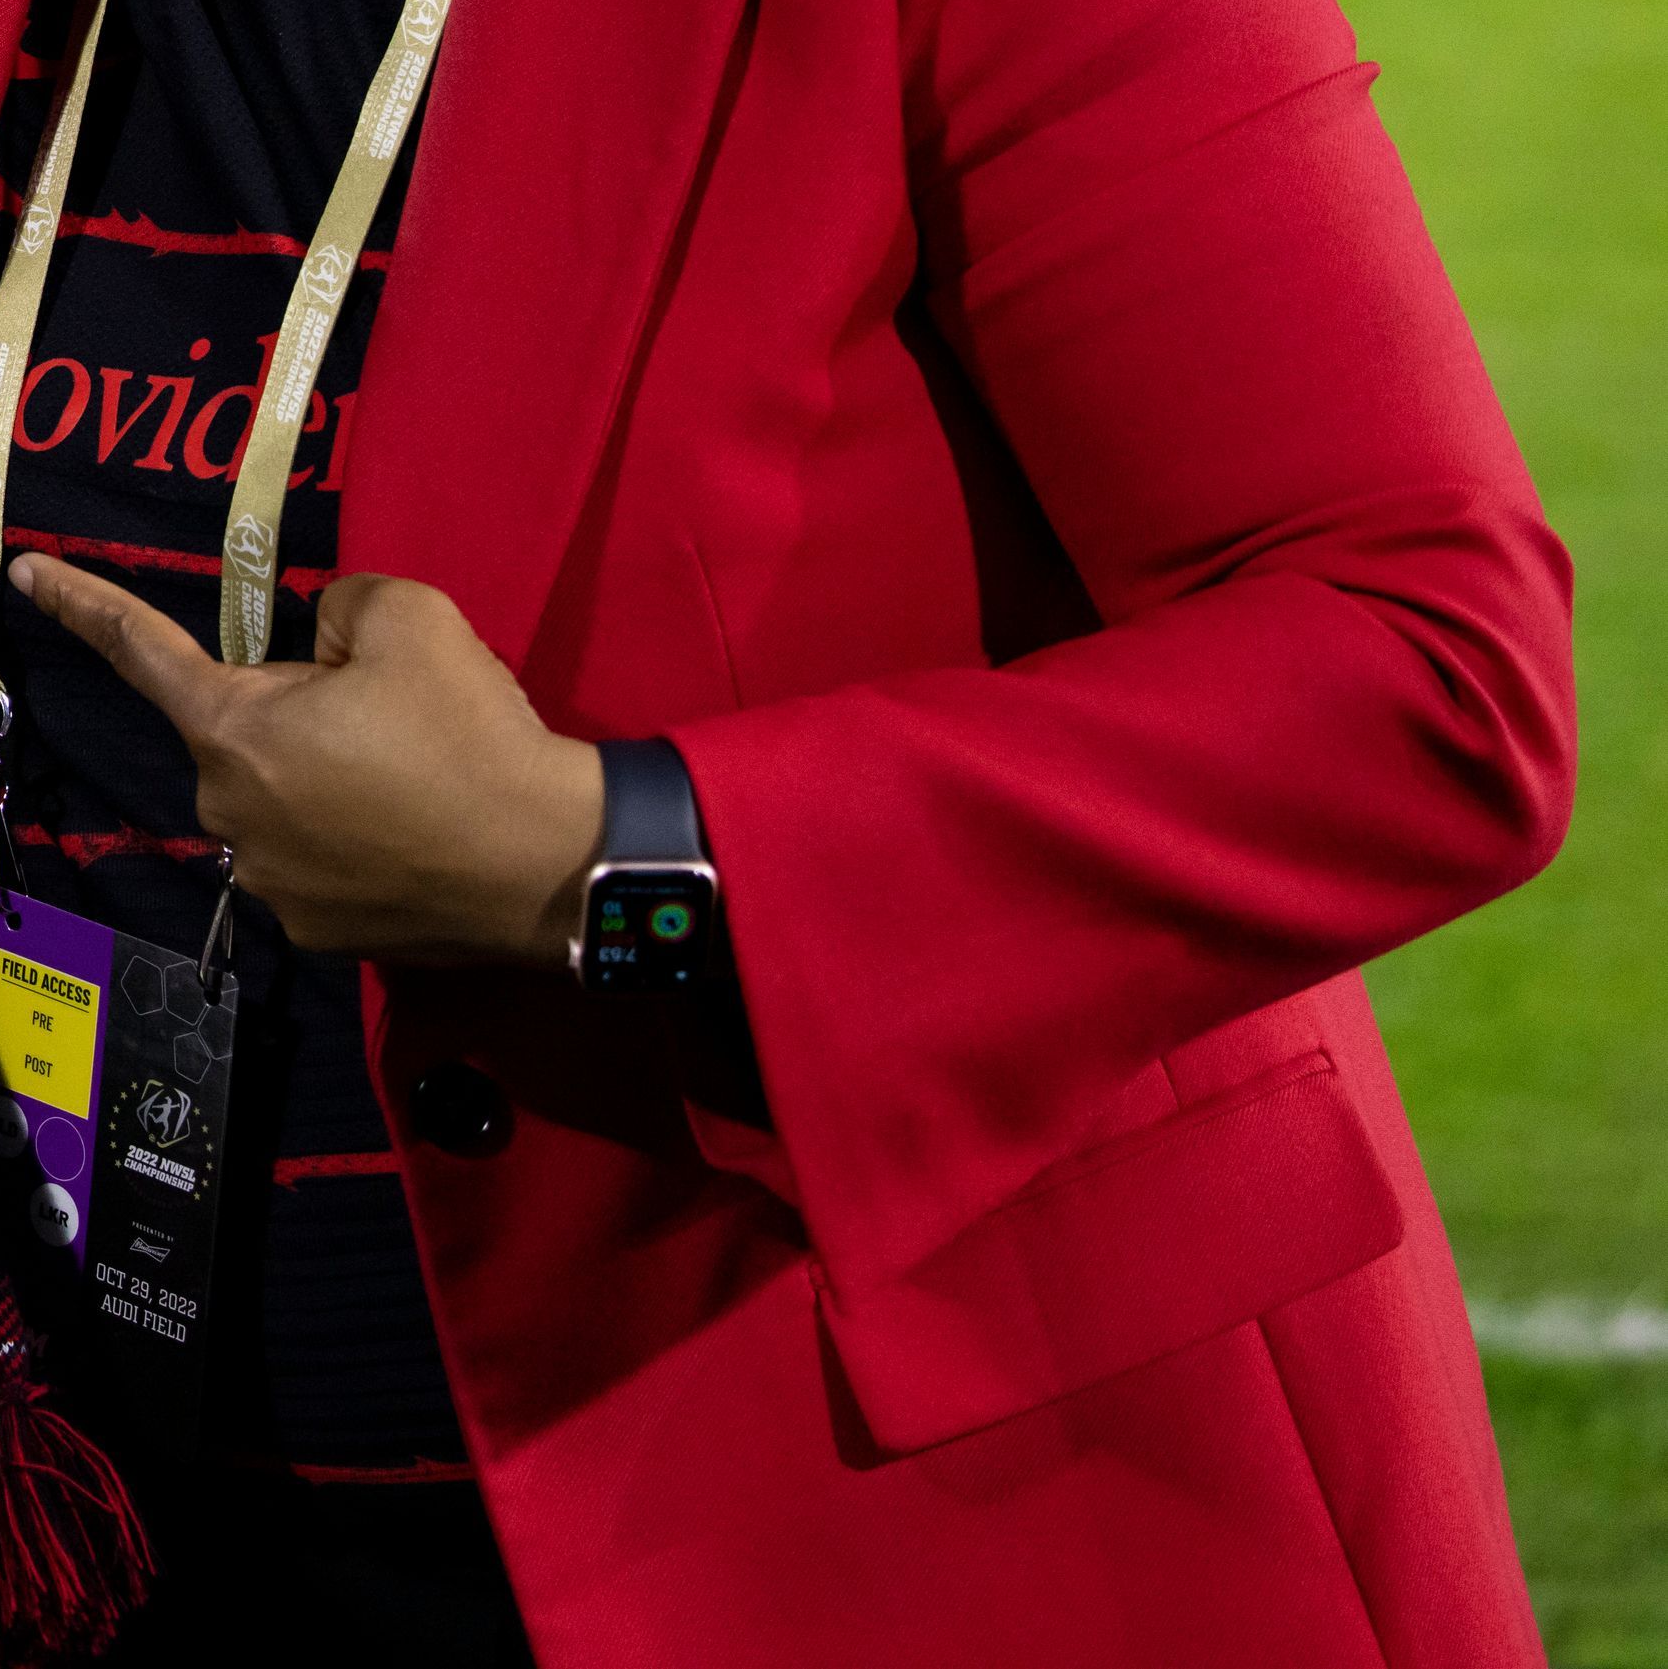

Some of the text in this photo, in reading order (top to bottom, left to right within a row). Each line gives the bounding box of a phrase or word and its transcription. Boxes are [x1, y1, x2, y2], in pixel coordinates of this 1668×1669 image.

[369, 50, 415, 157] CHAMPIONSHIP
[377, 54, 425, 159] 2022 NWSL
[276, 307, 316, 421] CHAMPIONSHIP
[285, 312, 329, 423] 2022 NWSL
[253, 587, 265, 640] 2022
[2, 958, 91, 1006] FIELD ACCESS
[32, 1010, 54, 1032] PRE
[25, 1054, 53, 1078] POST
[124, 1158, 194, 1192] CHAMPIONSHIP
[127, 1145, 196, 1183] 2022 NWSL
[39, 1202, 69, 1227] LKR
[96, 1263, 197, 1319] OCT 29, 2022
[101, 1294, 186, 1343] AUDI FIELD
